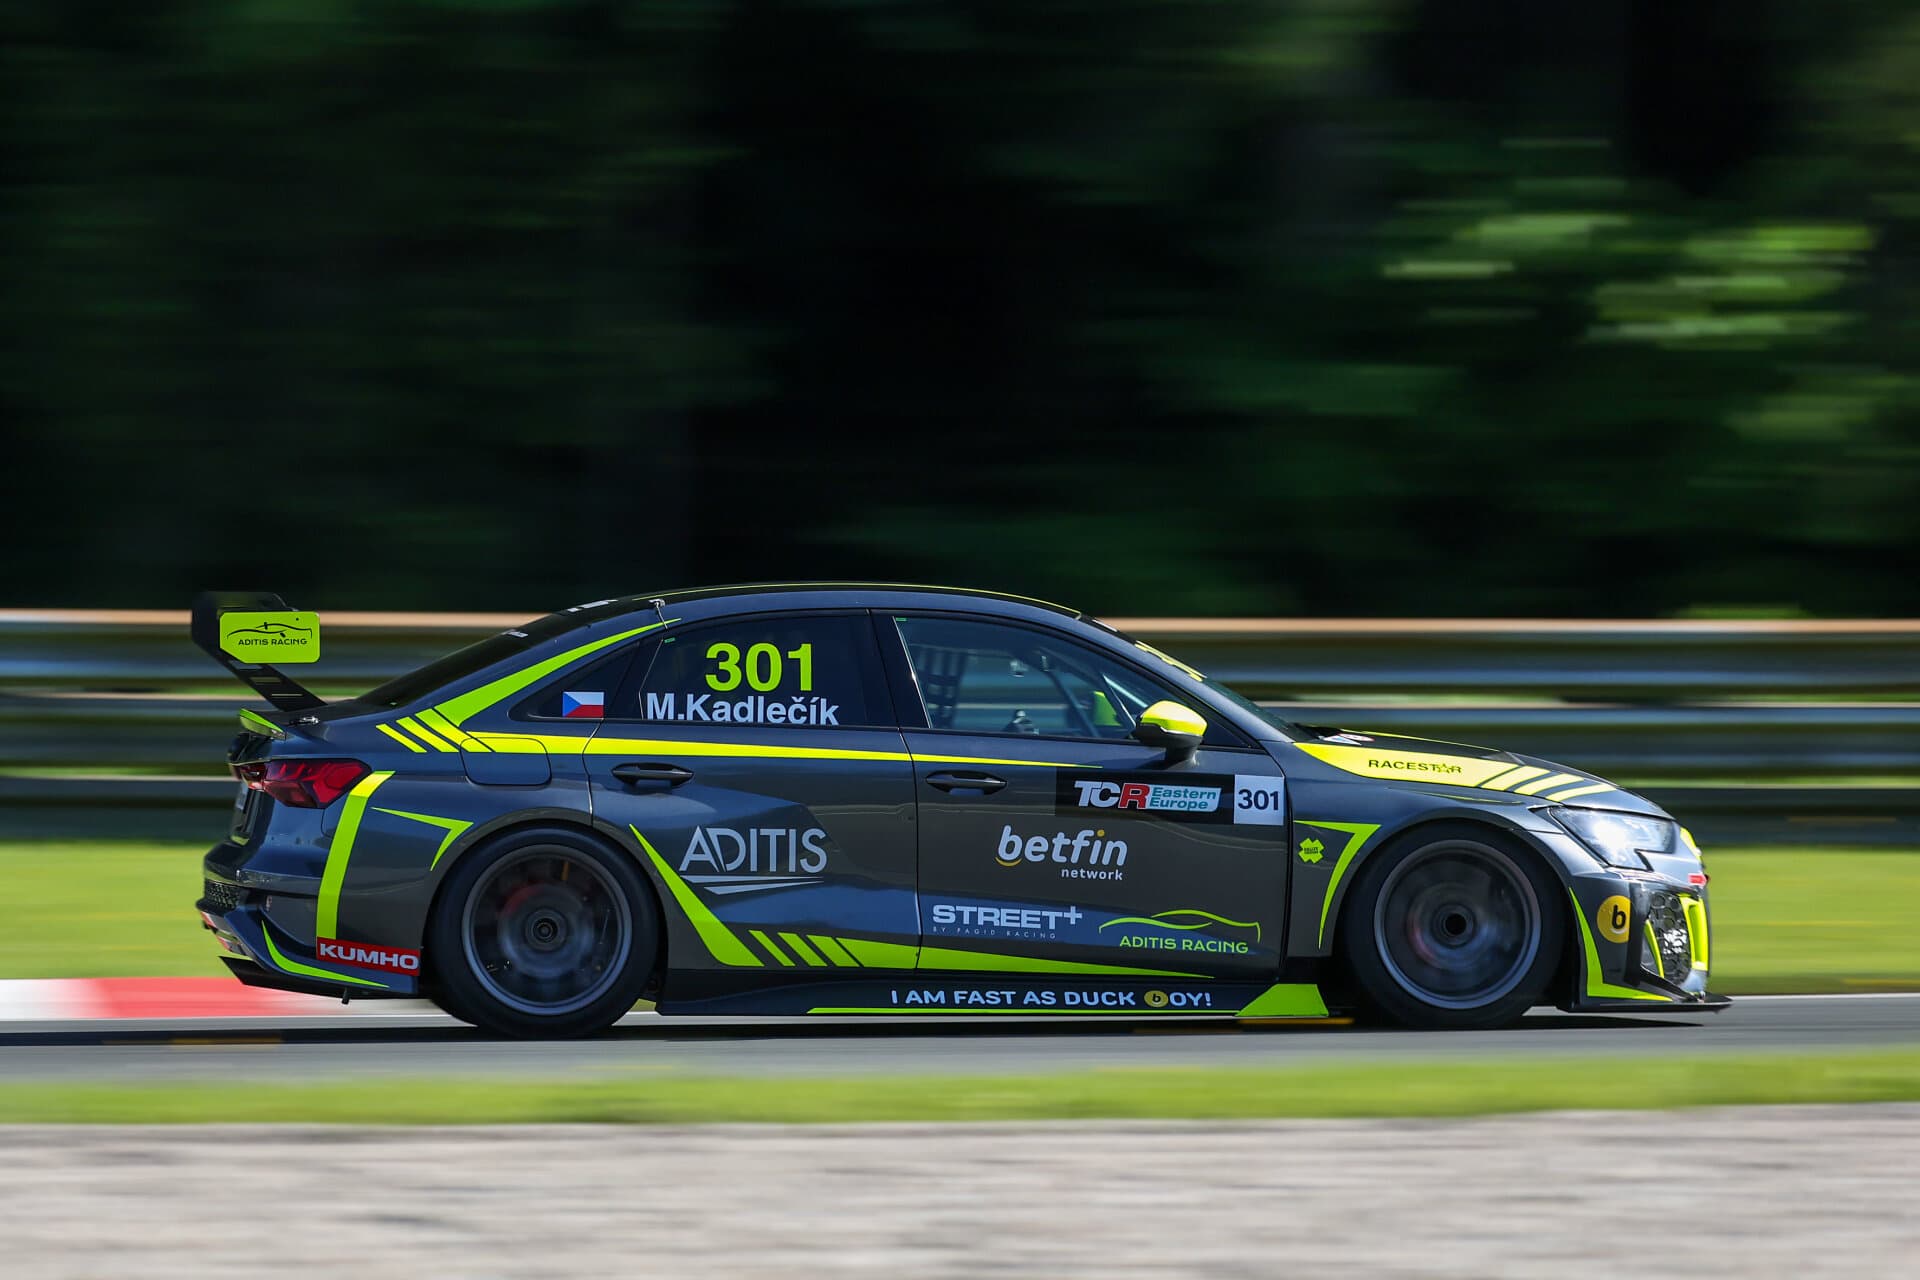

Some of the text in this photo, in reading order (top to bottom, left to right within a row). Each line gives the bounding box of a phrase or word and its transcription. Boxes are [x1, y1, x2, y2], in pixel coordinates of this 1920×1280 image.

[238, 638, 308, 646] ADITIS RACING
[705, 642, 813, 692] 301
[646, 692, 840, 725] M.Kadlečík
[1074, 780, 1150, 809] TCR
[1151, 786, 1217, 800] Eastern
[1238, 789, 1279, 810] 301
[1148, 797, 1209, 811] Europe
[678, 825, 828, 873] ADITIS
[996, 824, 1128, 867] betfin
[1061, 868, 1124, 881] network
[1006, 930, 1056, 939] RACING
[1119, 935, 1249, 954] ADITIS RACING
[319, 943, 419, 970] KUMHO
[891, 990, 898, 1004] I
[905, 990, 946, 1004] AM
[953, 990, 1016, 1005] FAST
[1023, 990, 1057, 1006] AS
[1064, 991, 1136, 1006] DUCK
